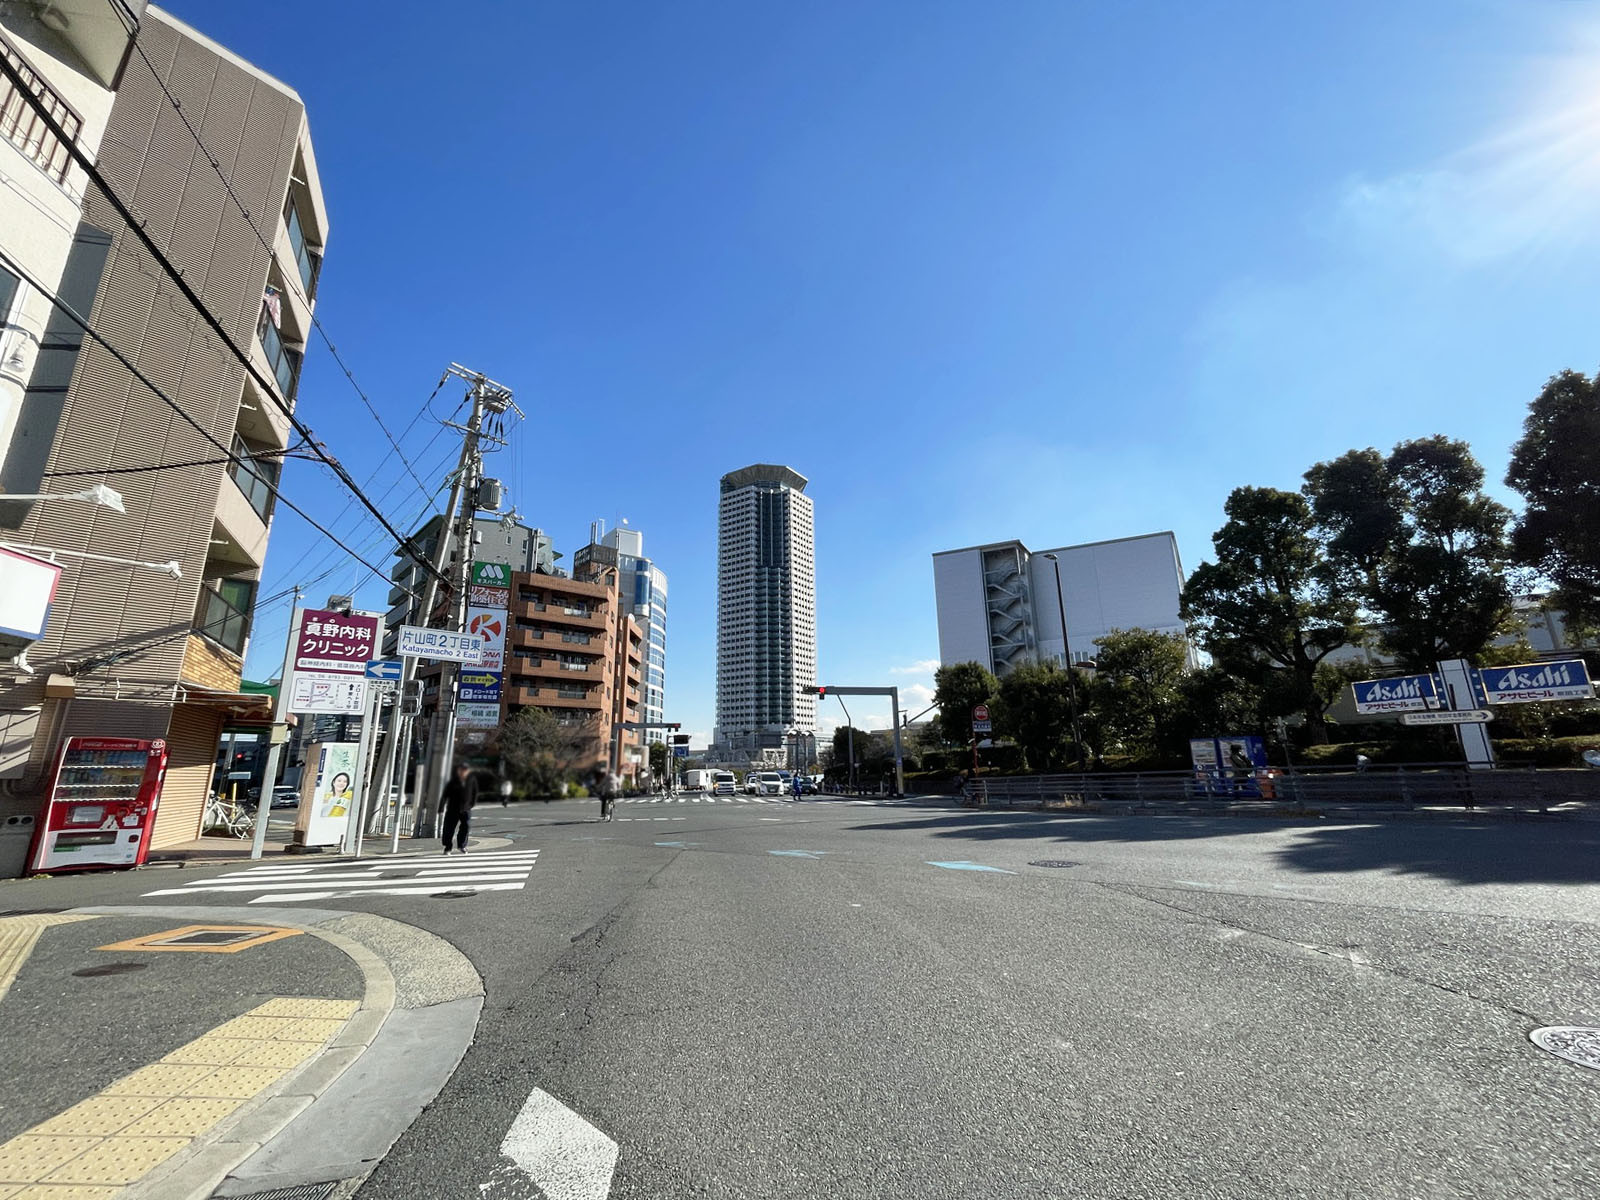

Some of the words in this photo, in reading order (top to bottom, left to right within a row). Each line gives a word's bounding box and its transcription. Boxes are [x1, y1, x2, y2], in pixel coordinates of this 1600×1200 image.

[305, 621, 371, 641] 真野内科
[303, 639, 369, 657] クリニック
[402, 631, 481, 652] 片山町2丁目東
[402, 644, 453, 656] Katayamacho
[463, 651, 479, 659] East
[1498, 664, 1570, 690] Asahi
[1366, 678, 1420, 701] Asahi
[1497, 690, 1554, 700] アサヒビール
[1365, 701, 1409, 710] アサヒビール
